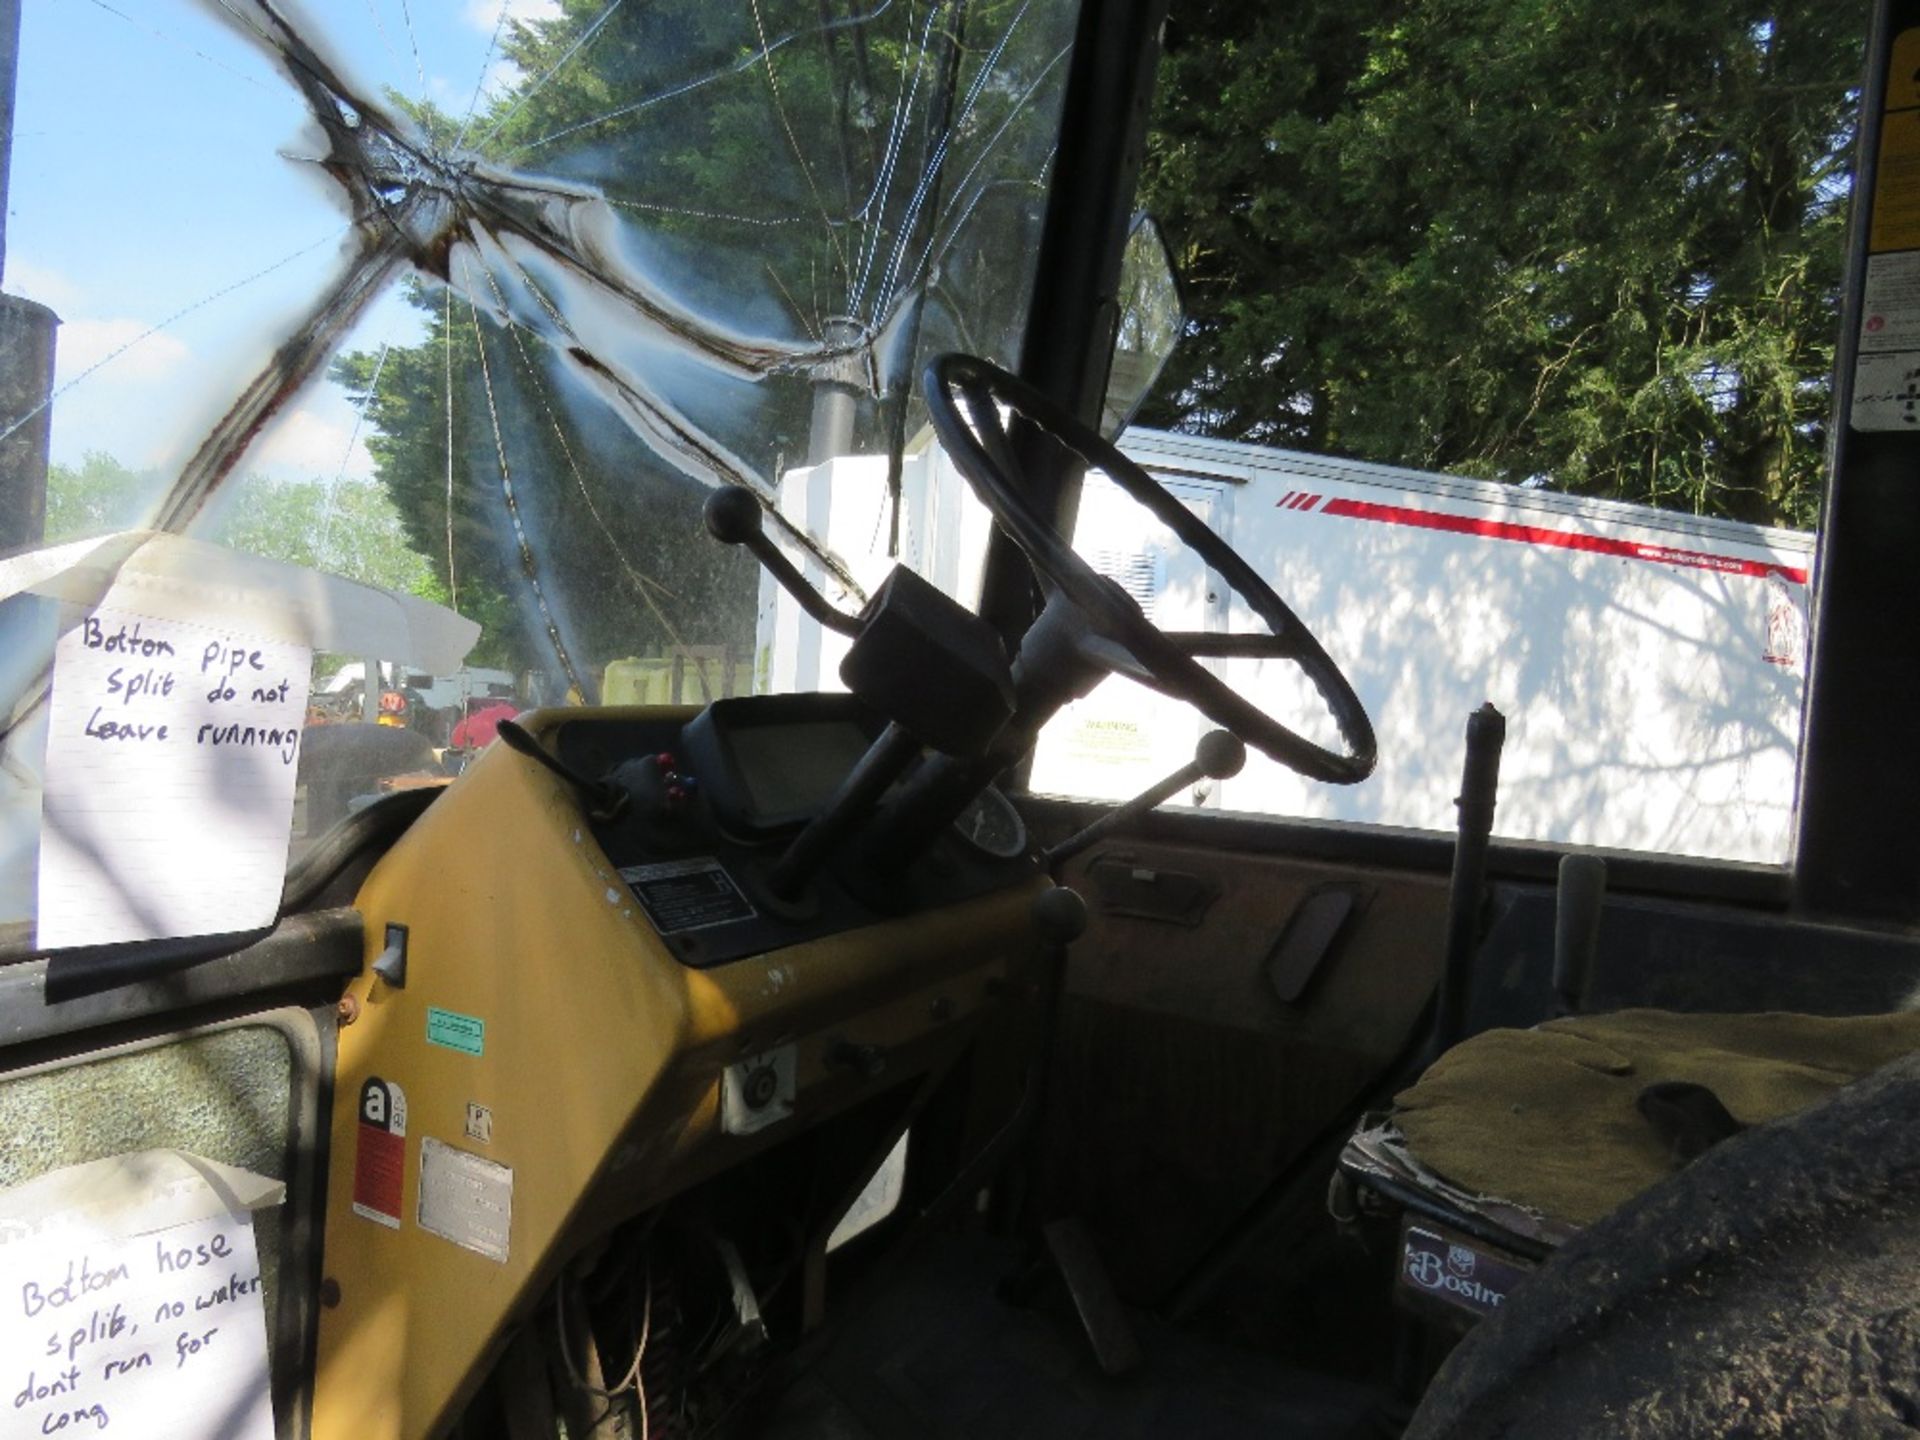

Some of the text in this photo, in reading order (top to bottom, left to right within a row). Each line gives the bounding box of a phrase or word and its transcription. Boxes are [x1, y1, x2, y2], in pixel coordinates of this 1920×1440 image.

[84, 617, 265, 677] Bottom pipe
[207, 676, 236, 703] do
[251, 679, 290, 703] not
[22, 1233, 233, 1317] Bottom hose
[155, 1300, 185, 1323] no
[104, 1352, 152, 1380] run
[176, 1327, 218, 1368] for
